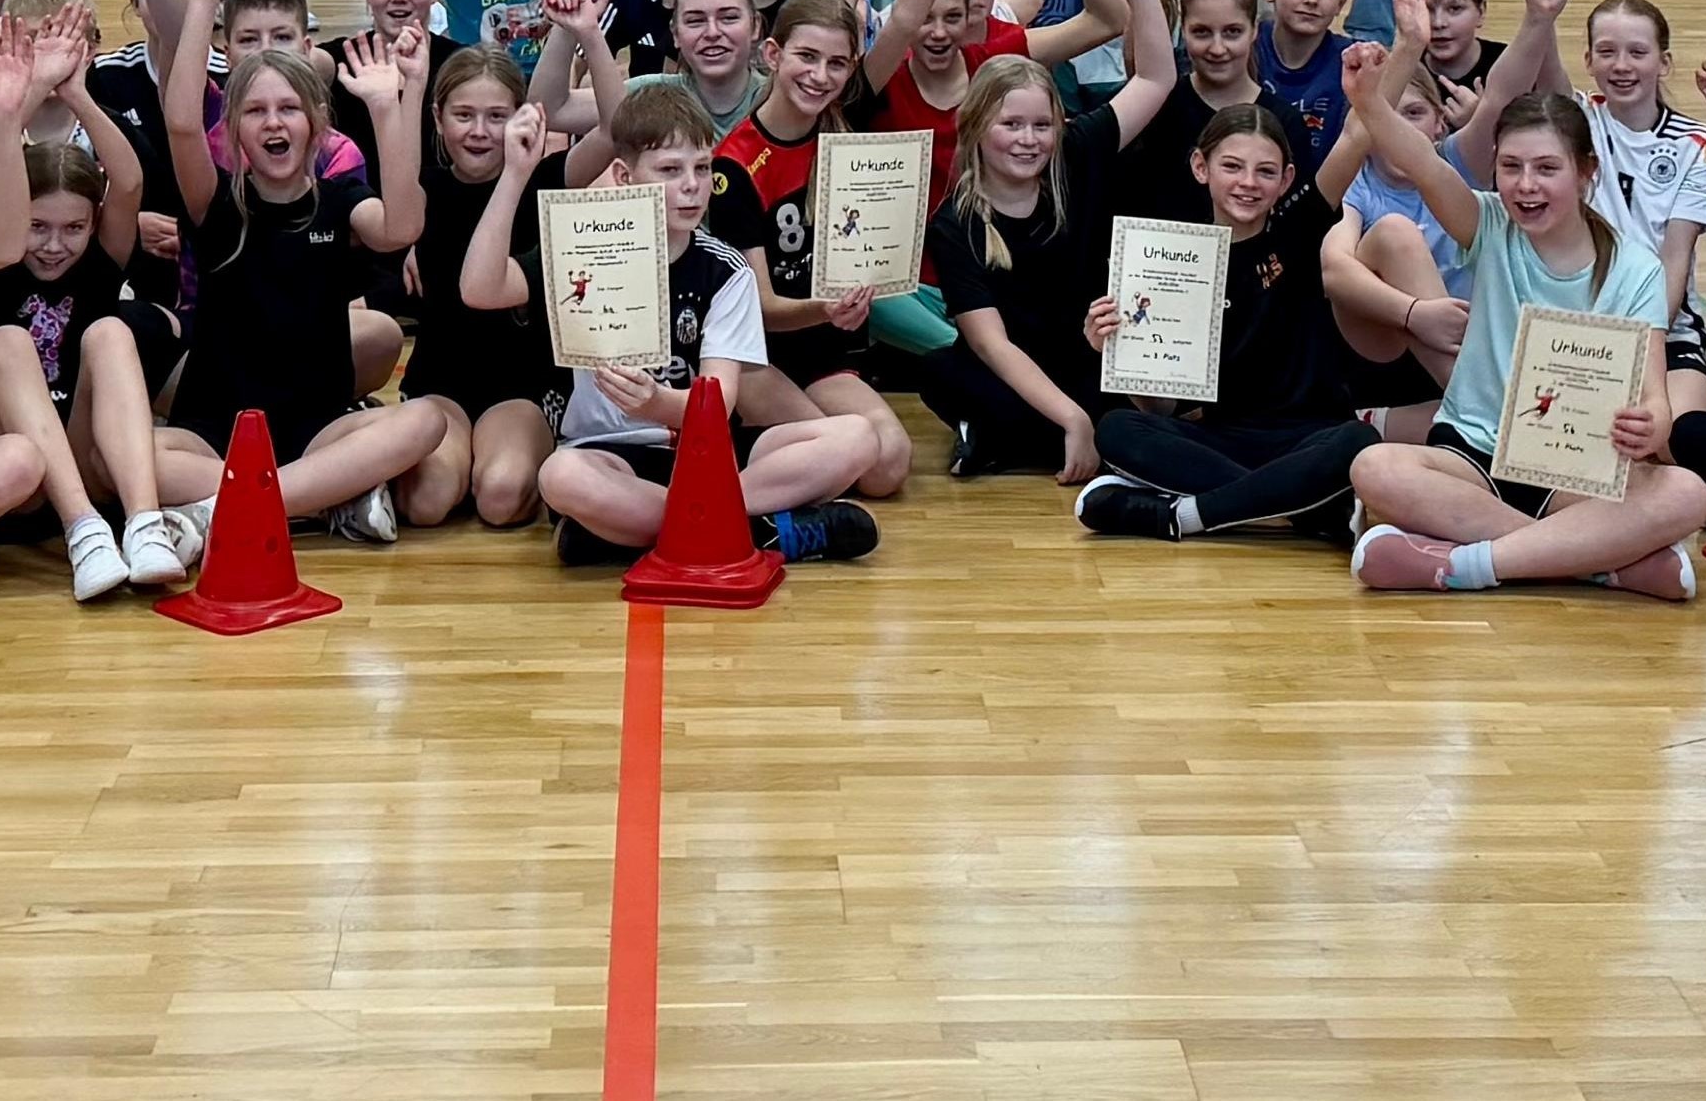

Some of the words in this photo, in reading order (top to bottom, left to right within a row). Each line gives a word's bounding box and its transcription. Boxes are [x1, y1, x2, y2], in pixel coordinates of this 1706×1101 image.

[850, 158, 904, 173] Urkunde
[573, 219, 635, 235] Urkunde
[776, 203, 805, 253] 8
[1143, 246, 1199, 264] Urkunde
[1551, 338, 1614, 361] Urkunde
